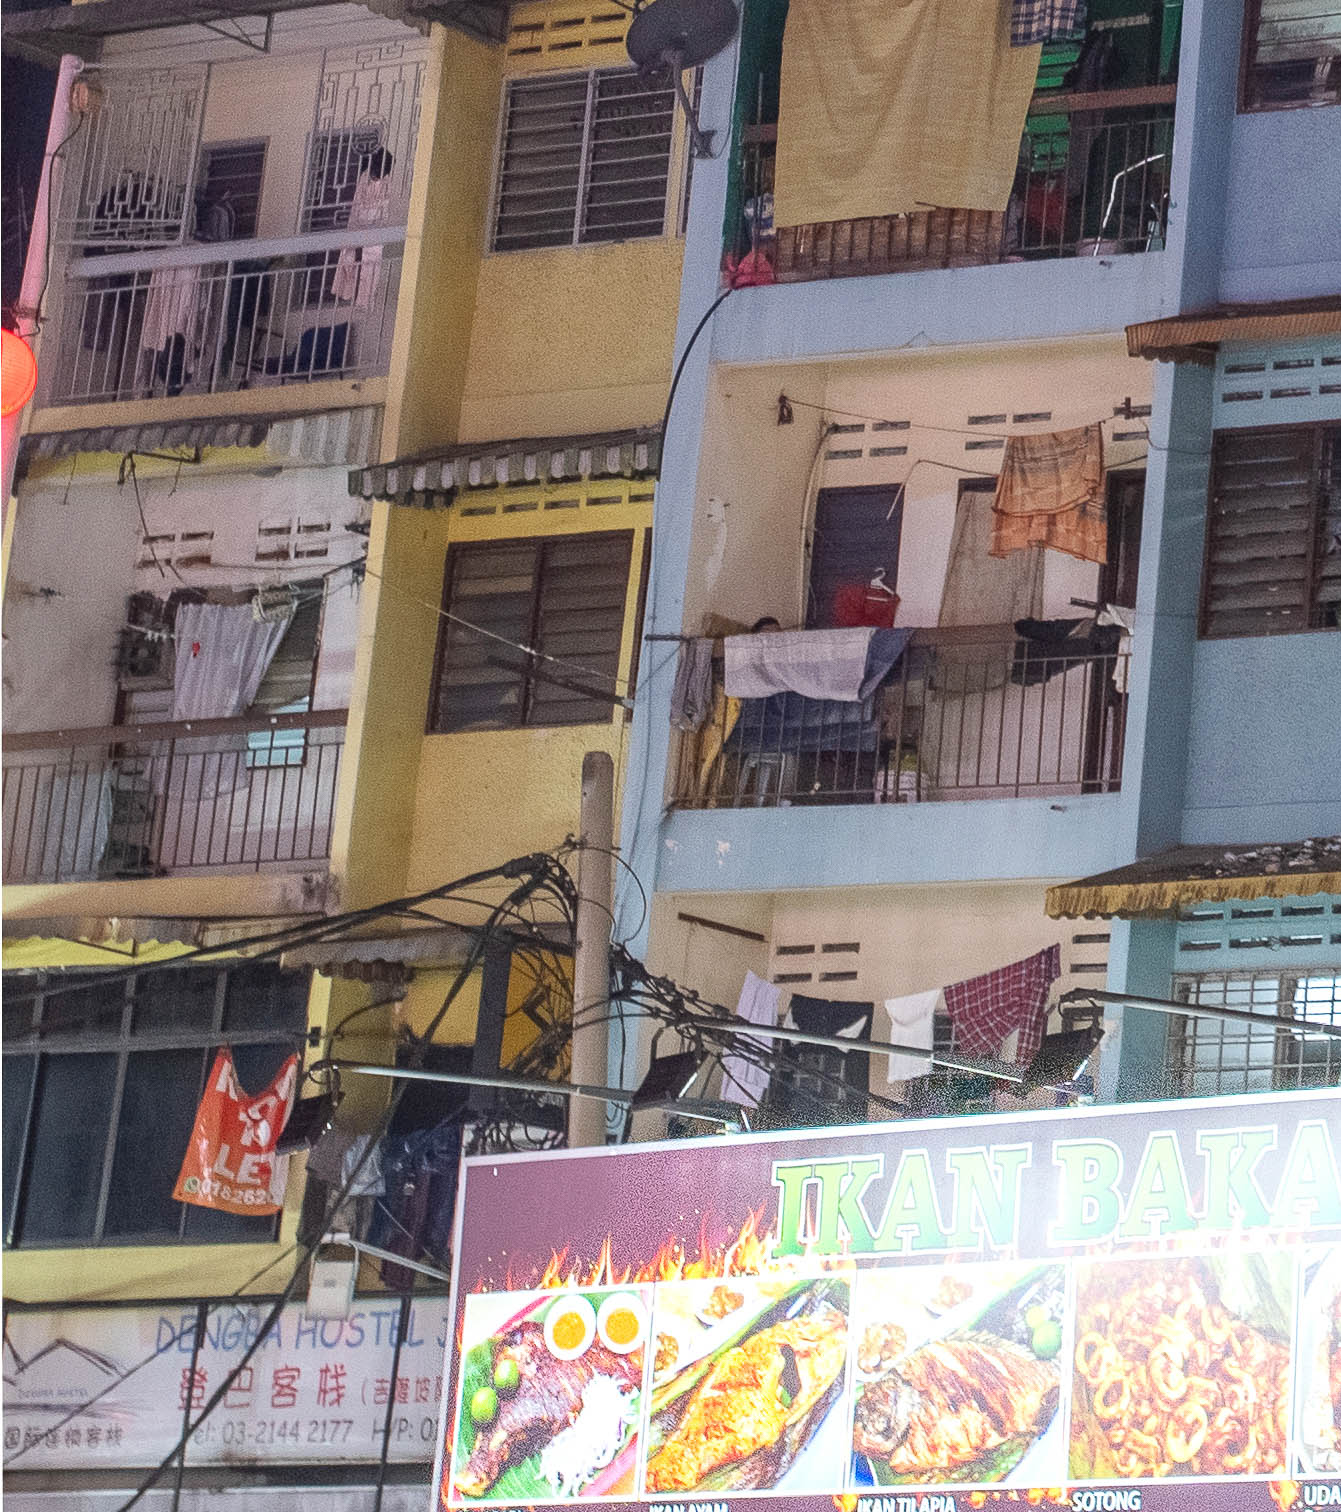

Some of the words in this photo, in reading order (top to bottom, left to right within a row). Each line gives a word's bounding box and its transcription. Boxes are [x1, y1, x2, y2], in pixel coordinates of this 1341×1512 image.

[771, 1140, 1034, 1263] IKAN
[156, 1307, 282, 1354] DENGBA
[295, 1308, 424, 1350] HOSTEL
[307, 1419, 354, 1443] 2177
[1072, 1490, 1142, 1512] SOTONG
